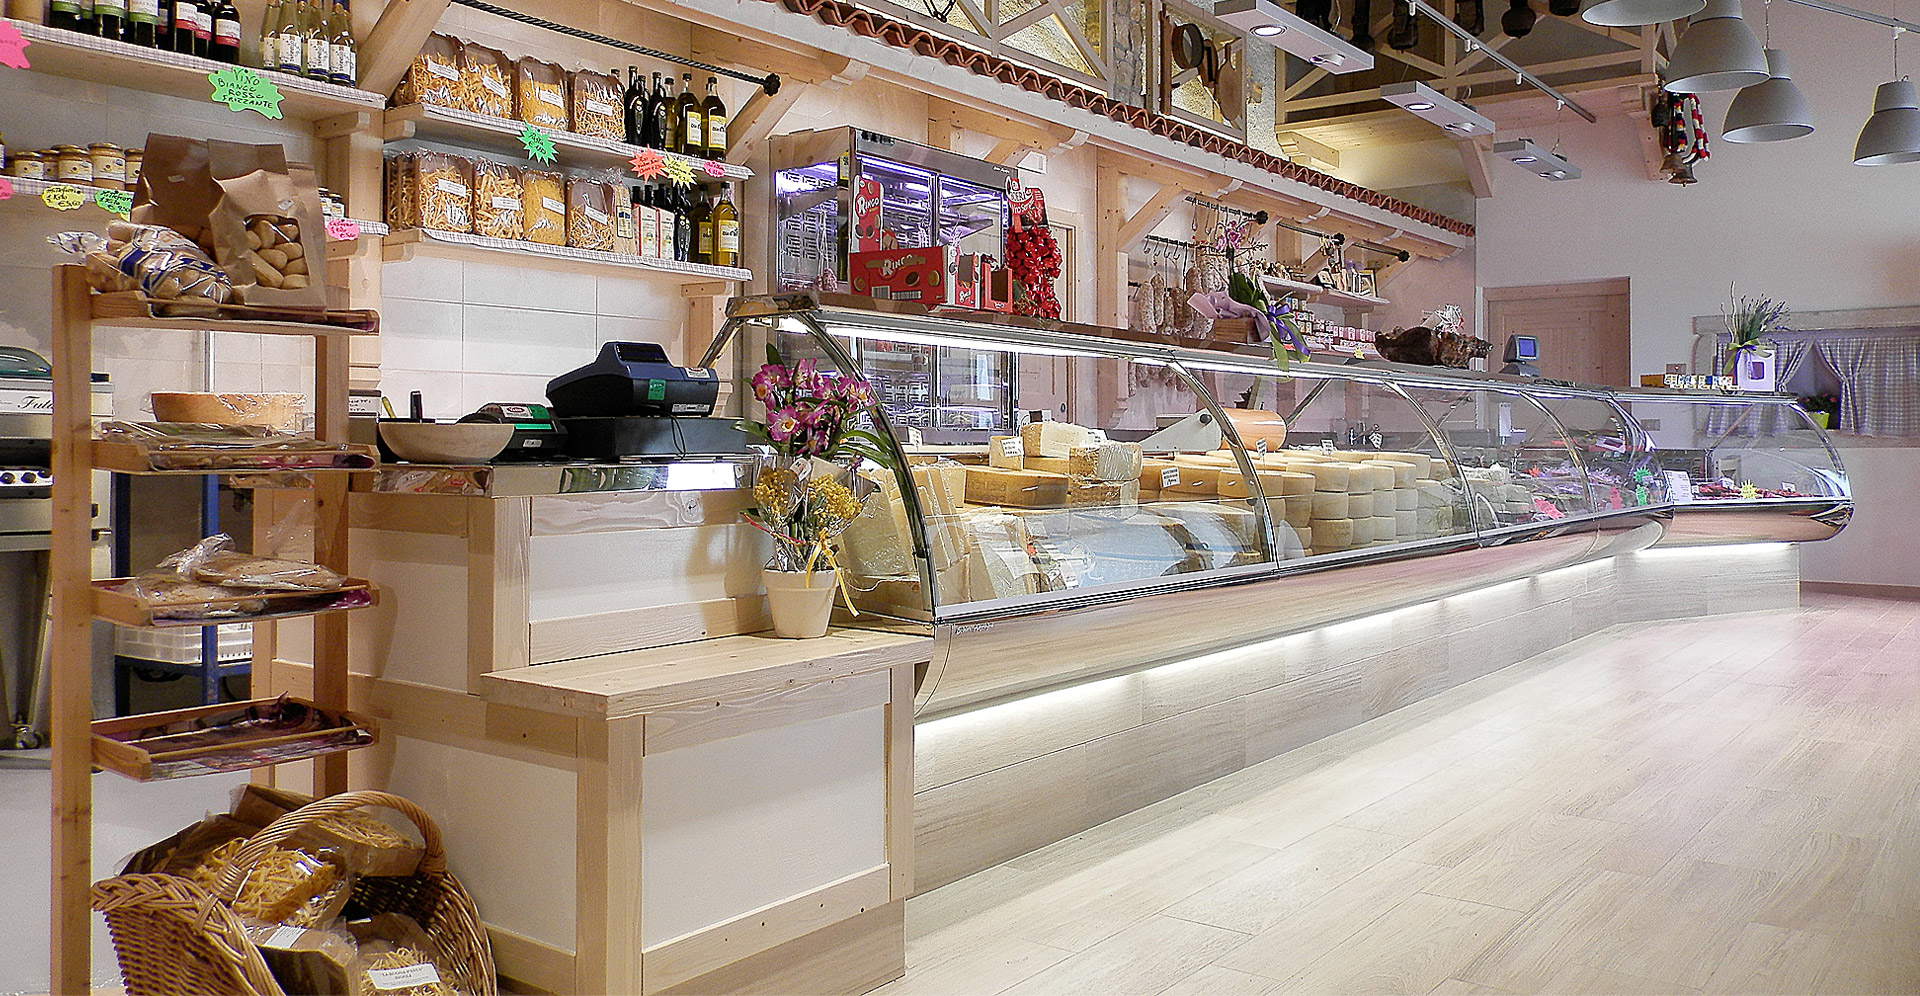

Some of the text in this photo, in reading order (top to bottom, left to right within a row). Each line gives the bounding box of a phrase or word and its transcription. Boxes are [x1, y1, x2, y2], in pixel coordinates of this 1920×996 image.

[233, 69, 260, 86] VINO
[222, 94, 273, 109] FRIZZANTE
[228, 88, 264, 99] ROSSO
[856, 195, 880, 215] RINGO
